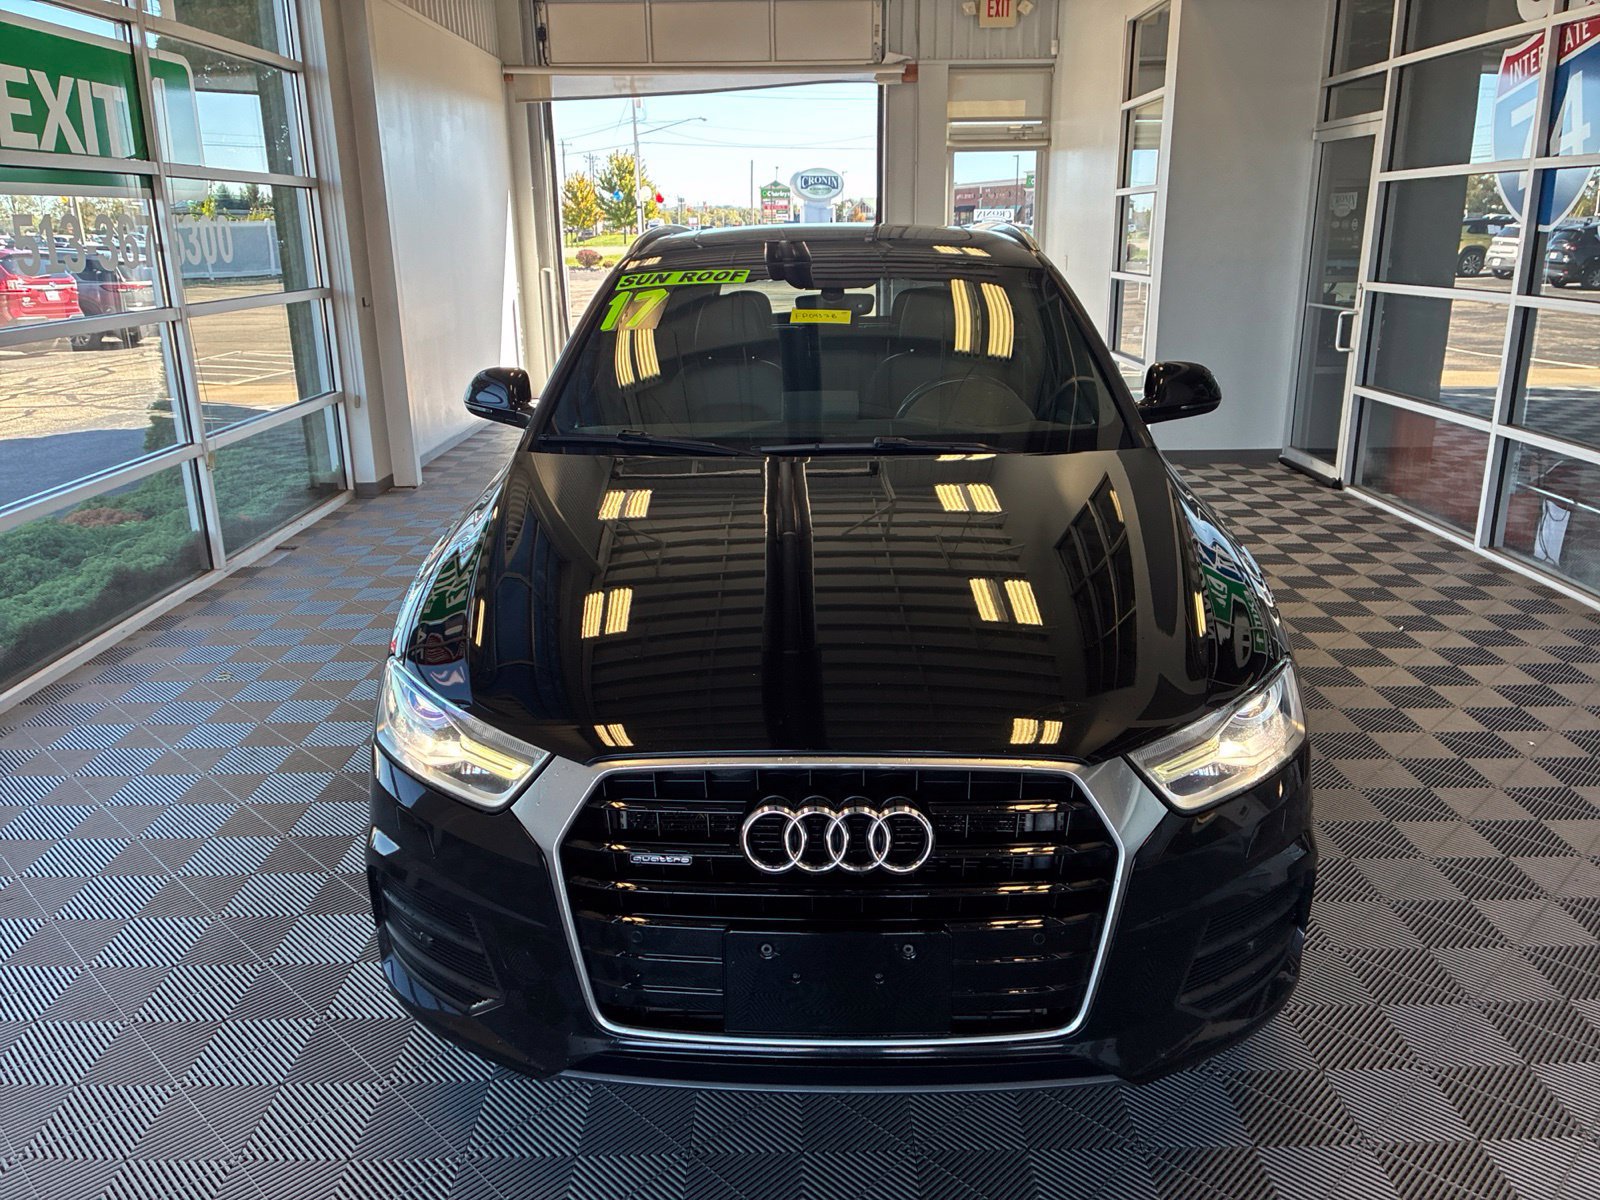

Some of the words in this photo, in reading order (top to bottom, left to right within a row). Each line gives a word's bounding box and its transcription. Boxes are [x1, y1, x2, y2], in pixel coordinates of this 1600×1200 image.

[986, 0, 1010, 17] EXIT
[0, 63, 135, 158] EXIT
[1511, 70, 1591, 191] 74
[801, 176, 838, 189] CRONIN
[619, 272, 672, 287] SUN
[679, 271, 746, 282] ROOF
[600, 288, 670, 331] 17
[632, 854, 691, 864] quattro
